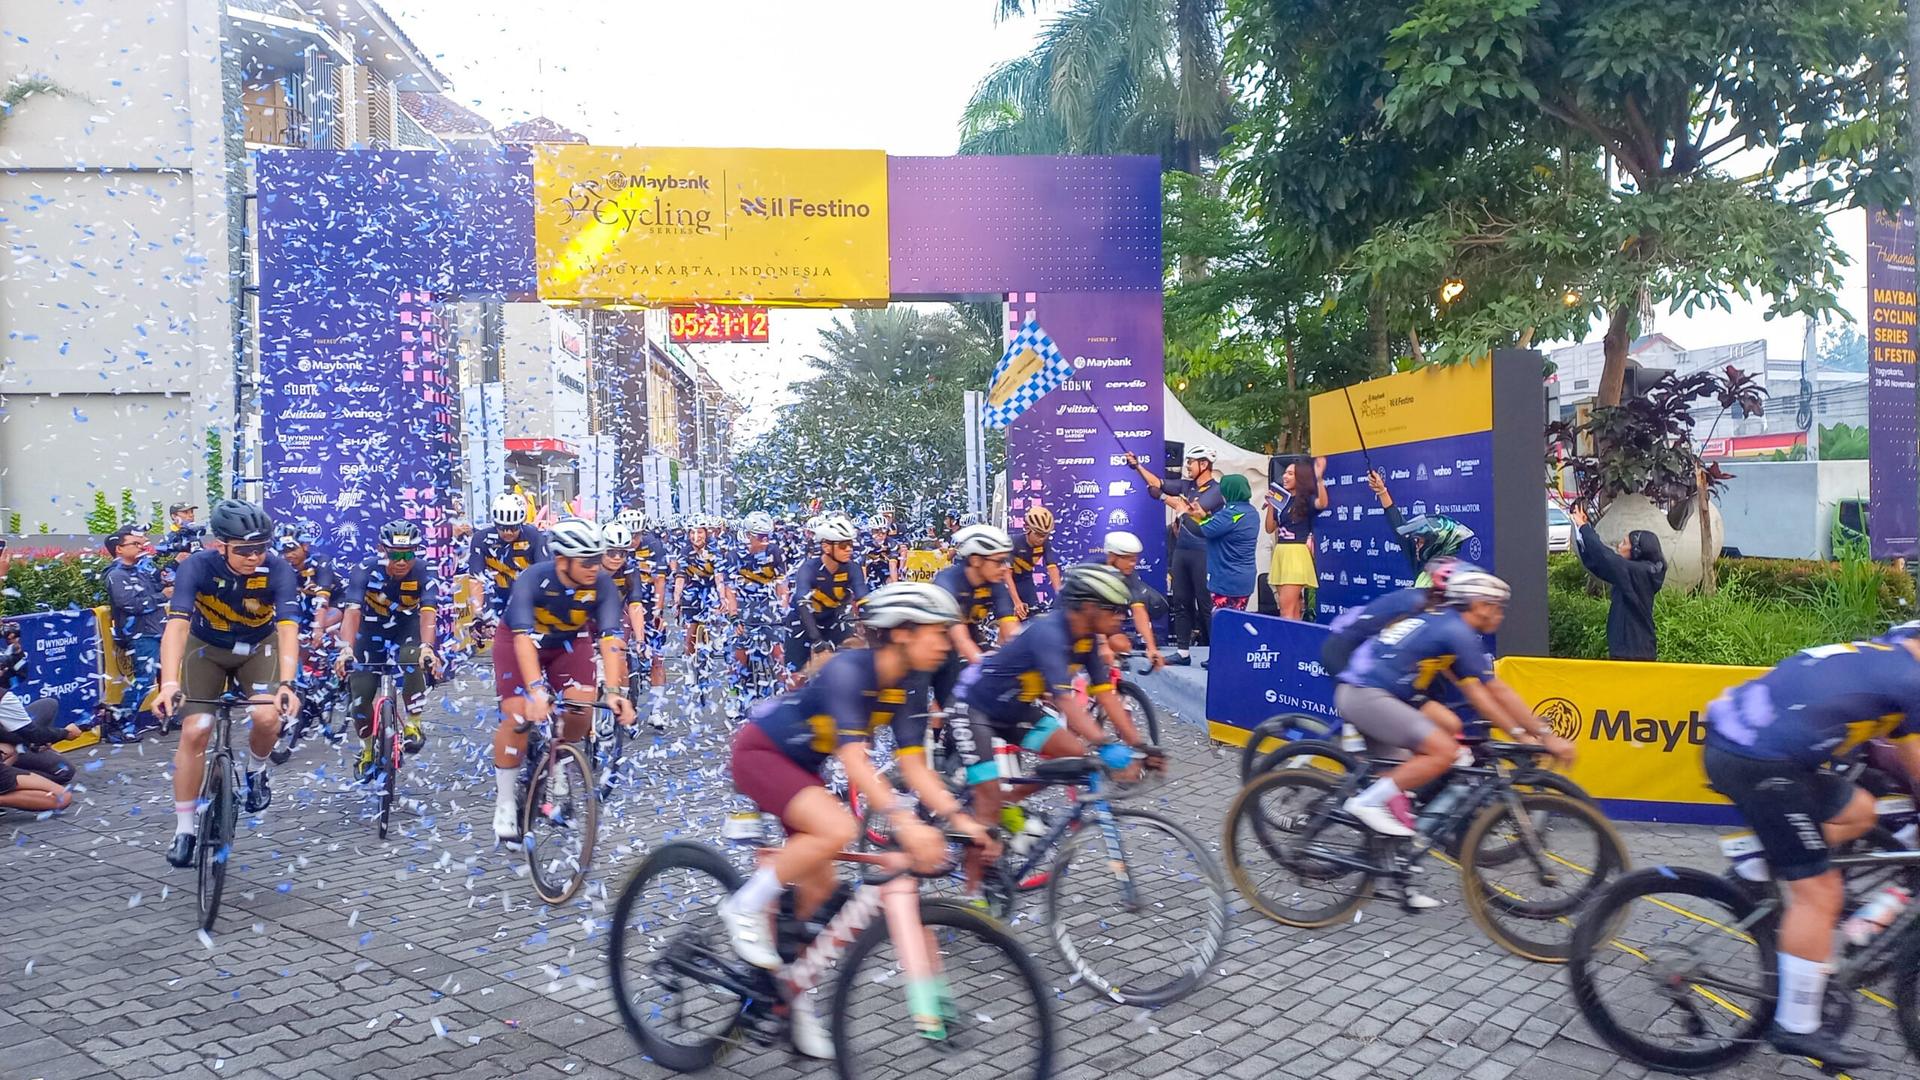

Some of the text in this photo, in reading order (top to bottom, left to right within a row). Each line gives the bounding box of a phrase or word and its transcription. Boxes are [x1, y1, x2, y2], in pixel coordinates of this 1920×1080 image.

[630, 175, 709, 191] Maybank
[788, 199, 870, 217] Festino
[593, 195, 711, 234] Cycling
[649, 227, 694, 235] SERIES
[590, 265, 832, 277] YOGYAKARTA, INDONESIA
[1874, 288, 1916, 307] MAYBA
[671, 312, 767, 336] 05:21:12
[1874, 327, 1908, 344] SERIES
[1885, 348, 1916, 364] FESTIN
[312, 361, 362, 373] Maybank
[1087, 357, 1131, 368] Maybank
[1106, 380, 1146, 388] cervélo
[1114, 402, 1148, 412] wahoo
[1114, 430, 1152, 438] SHARP
[1057, 455, 1150, 466] SRAM ISOUS
[1433, 465, 1452, 476] wahoo
[1074, 484, 1100, 494] AQUVIVA
[1440, 505, 1449, 513] SUN
[1450, 505, 1461, 513] STAR
[1462, 504, 1480, 512] MOTOR
[1395, 579, 1414, 587] SHARP
[45, 636, 78, 647] WYNDHAM
[1246, 652, 1280, 662] DRAFT
[1298, 661, 1329, 676] SHOK
[40, 681, 79, 697] SHARP
[1279, 694, 1299, 707] SUN
[1302, 700, 1327, 714] STAR
[1590, 709, 1708, 752] Mayb
